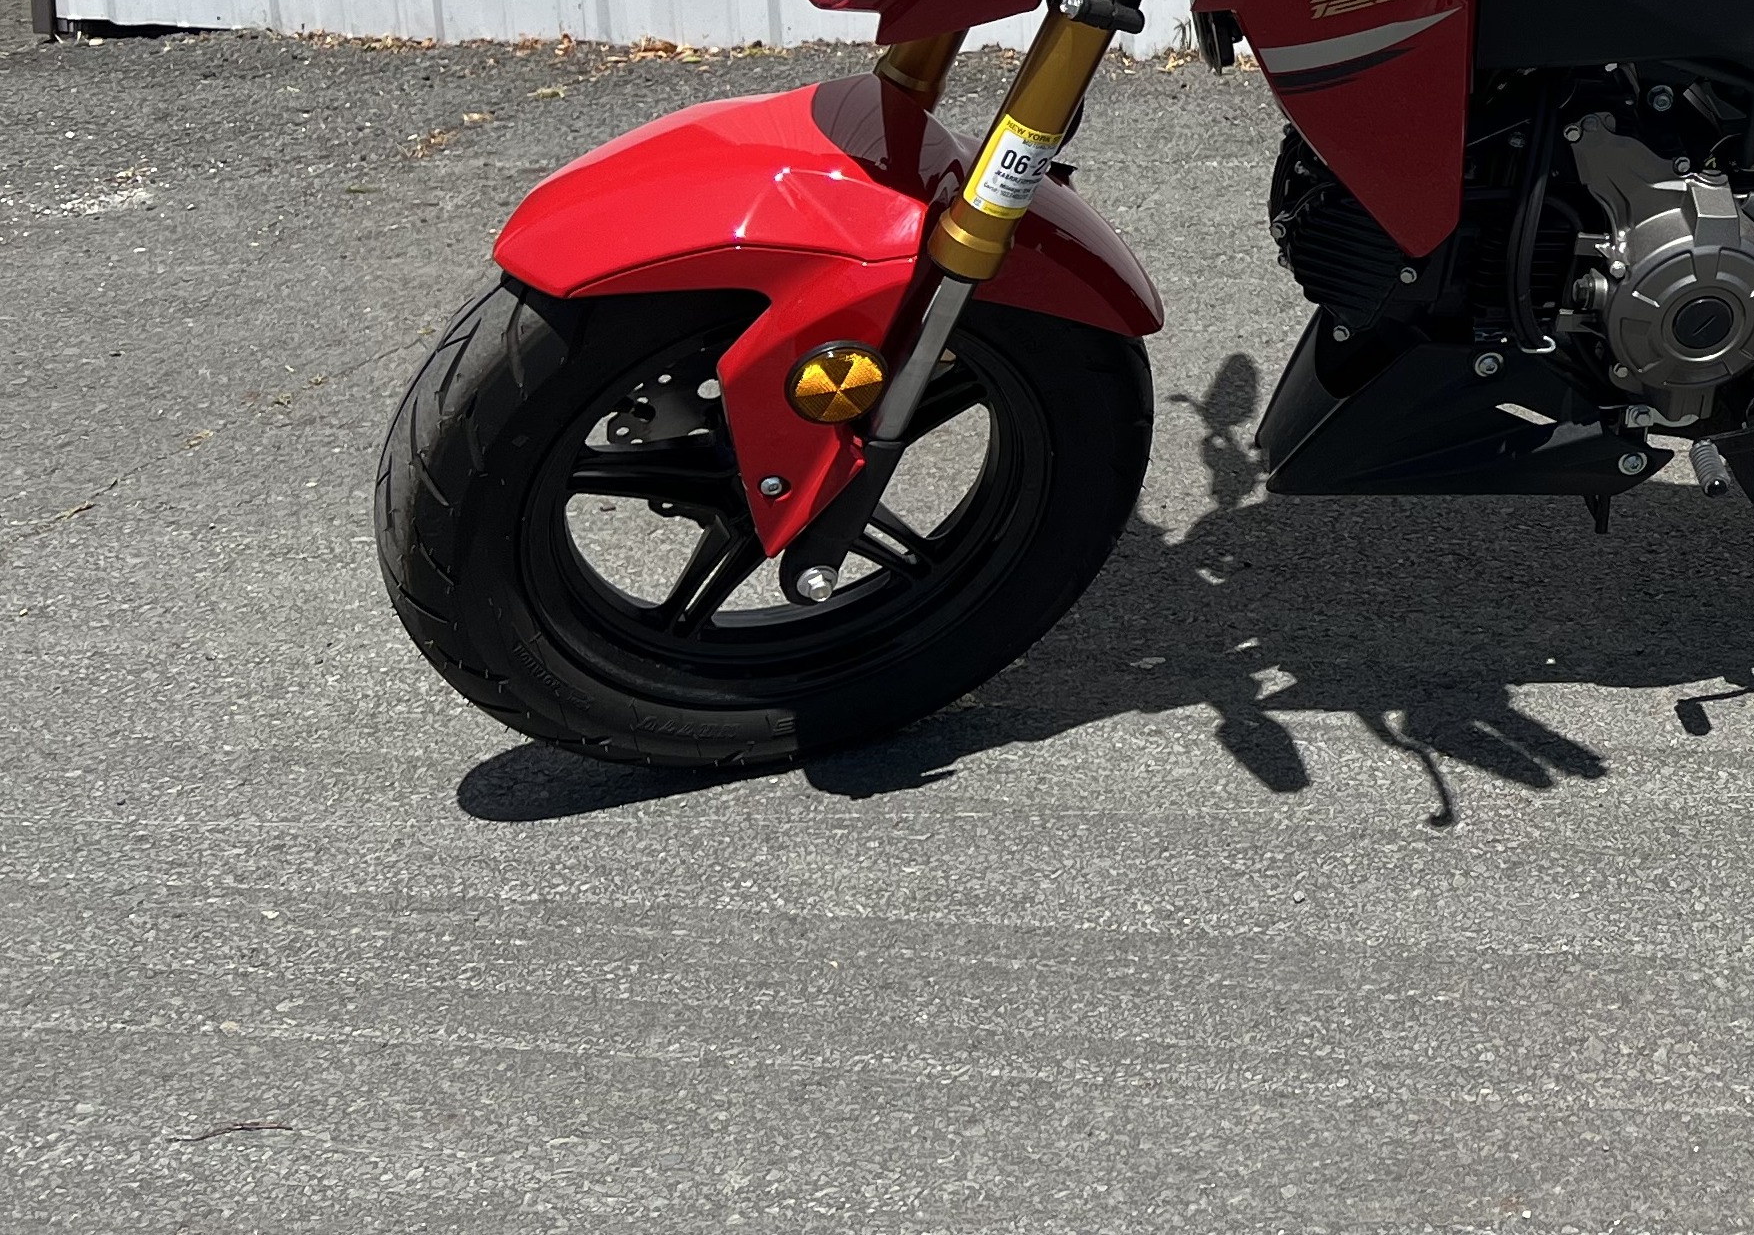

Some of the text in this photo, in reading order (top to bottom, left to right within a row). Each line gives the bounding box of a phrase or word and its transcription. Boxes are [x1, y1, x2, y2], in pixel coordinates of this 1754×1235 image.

[1006, 119, 1025, 135] NEW
[1027, 131, 1051, 143] YORK
[1000, 149, 1049, 177] 06 2
